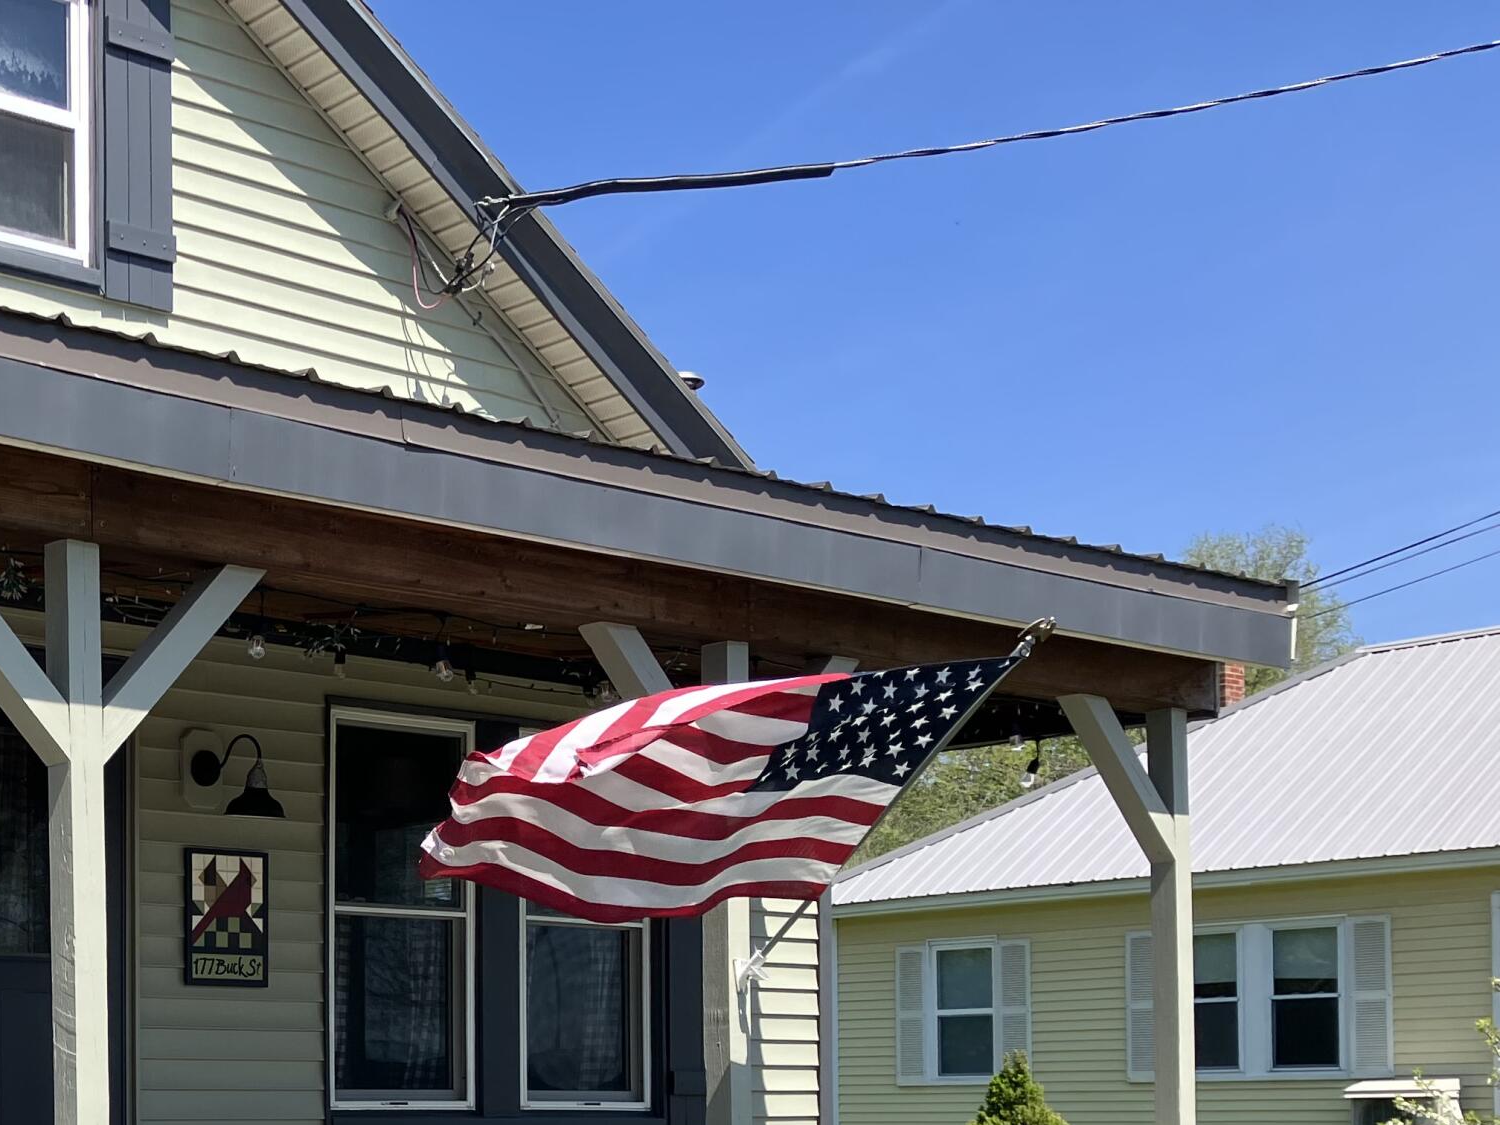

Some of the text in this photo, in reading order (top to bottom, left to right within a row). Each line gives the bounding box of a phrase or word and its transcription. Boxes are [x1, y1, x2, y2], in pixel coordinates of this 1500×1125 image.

[194, 957, 261, 978] 177 Buck St
